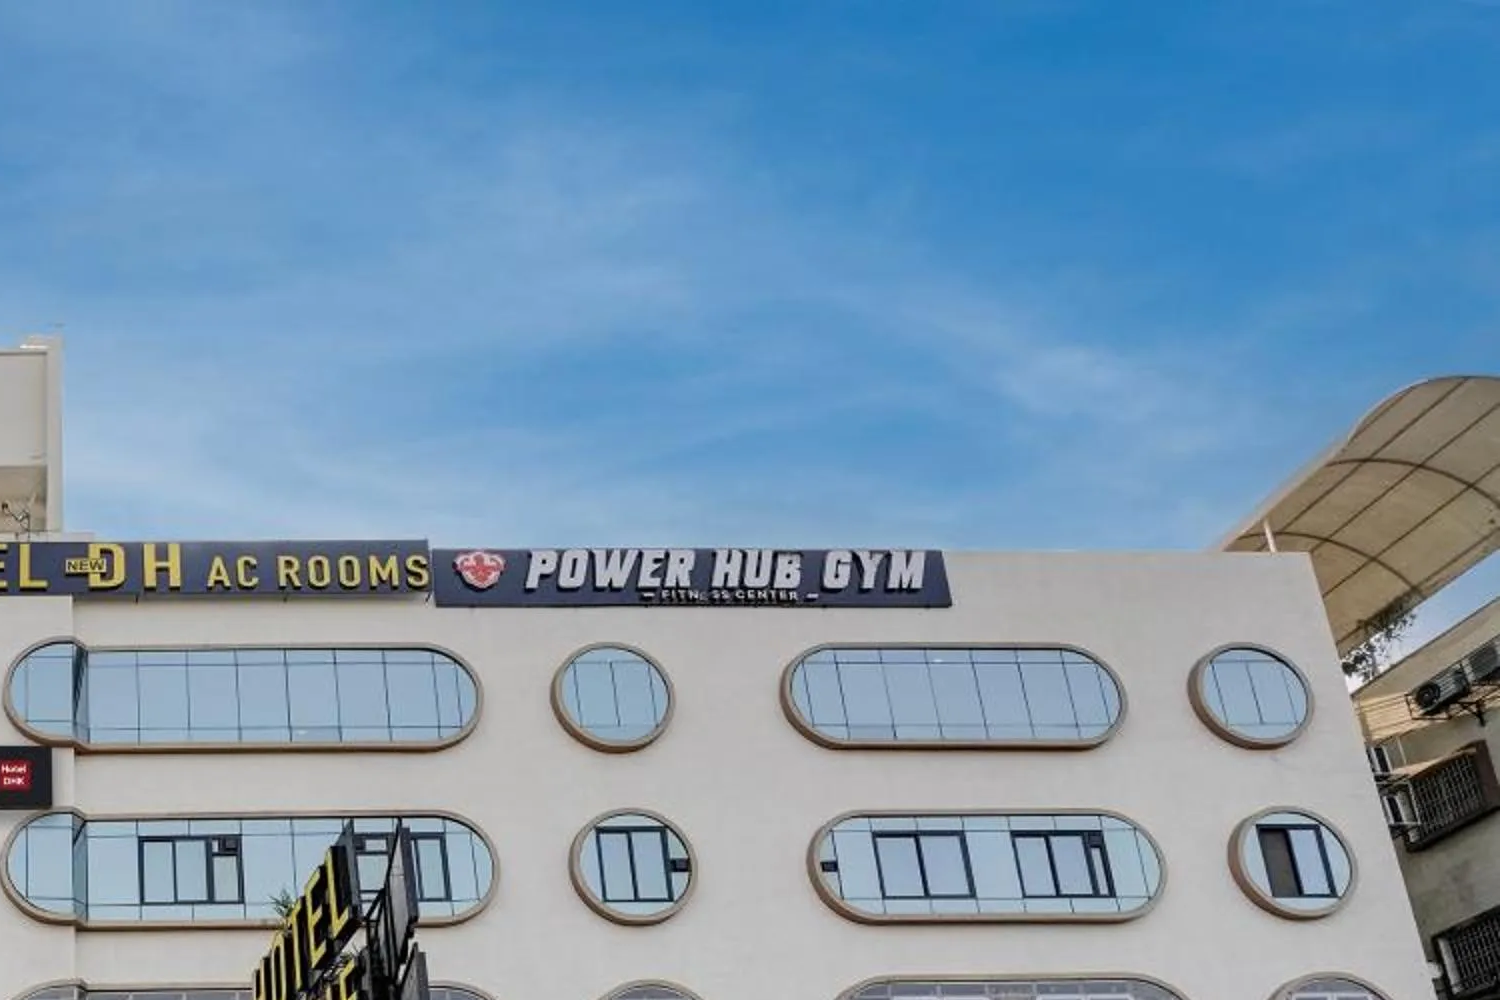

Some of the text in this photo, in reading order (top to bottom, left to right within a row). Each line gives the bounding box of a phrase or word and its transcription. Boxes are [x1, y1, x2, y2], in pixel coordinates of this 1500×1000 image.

[66, 560, 105, 573] NEW
[207, 557, 260, 589] AC
[277, 555, 430, 590] ROOMS
[525, 548, 925, 591] POWER HUB GYM
[661, 589, 799, 601] FITNSS CENTER
